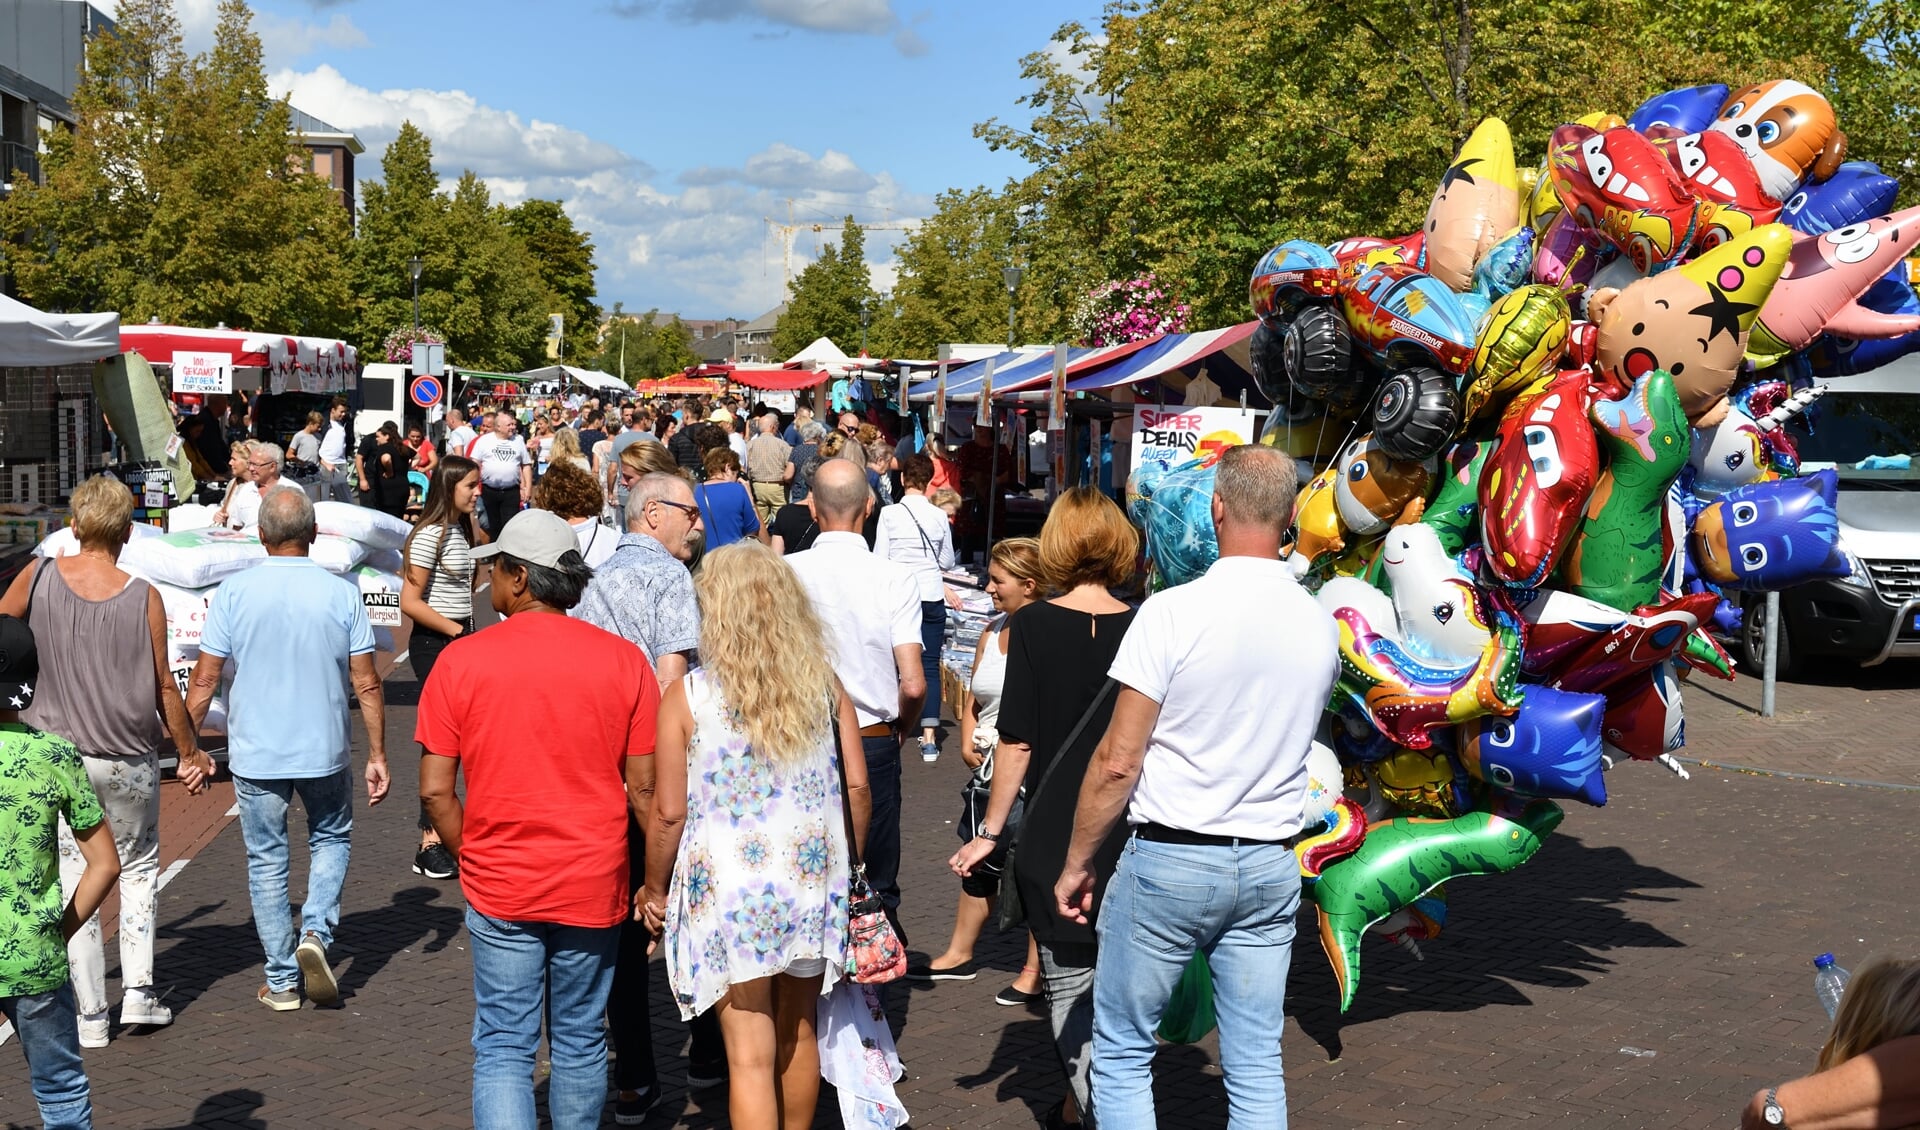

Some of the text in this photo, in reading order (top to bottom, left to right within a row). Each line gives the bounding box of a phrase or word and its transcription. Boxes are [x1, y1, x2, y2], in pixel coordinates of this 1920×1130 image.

[1140, 409, 1202, 431] SUPER
[1140, 428, 1197, 454] DEALS
[365, 594, 398, 606] ANTIE
[175, 629, 182, 637] 2
